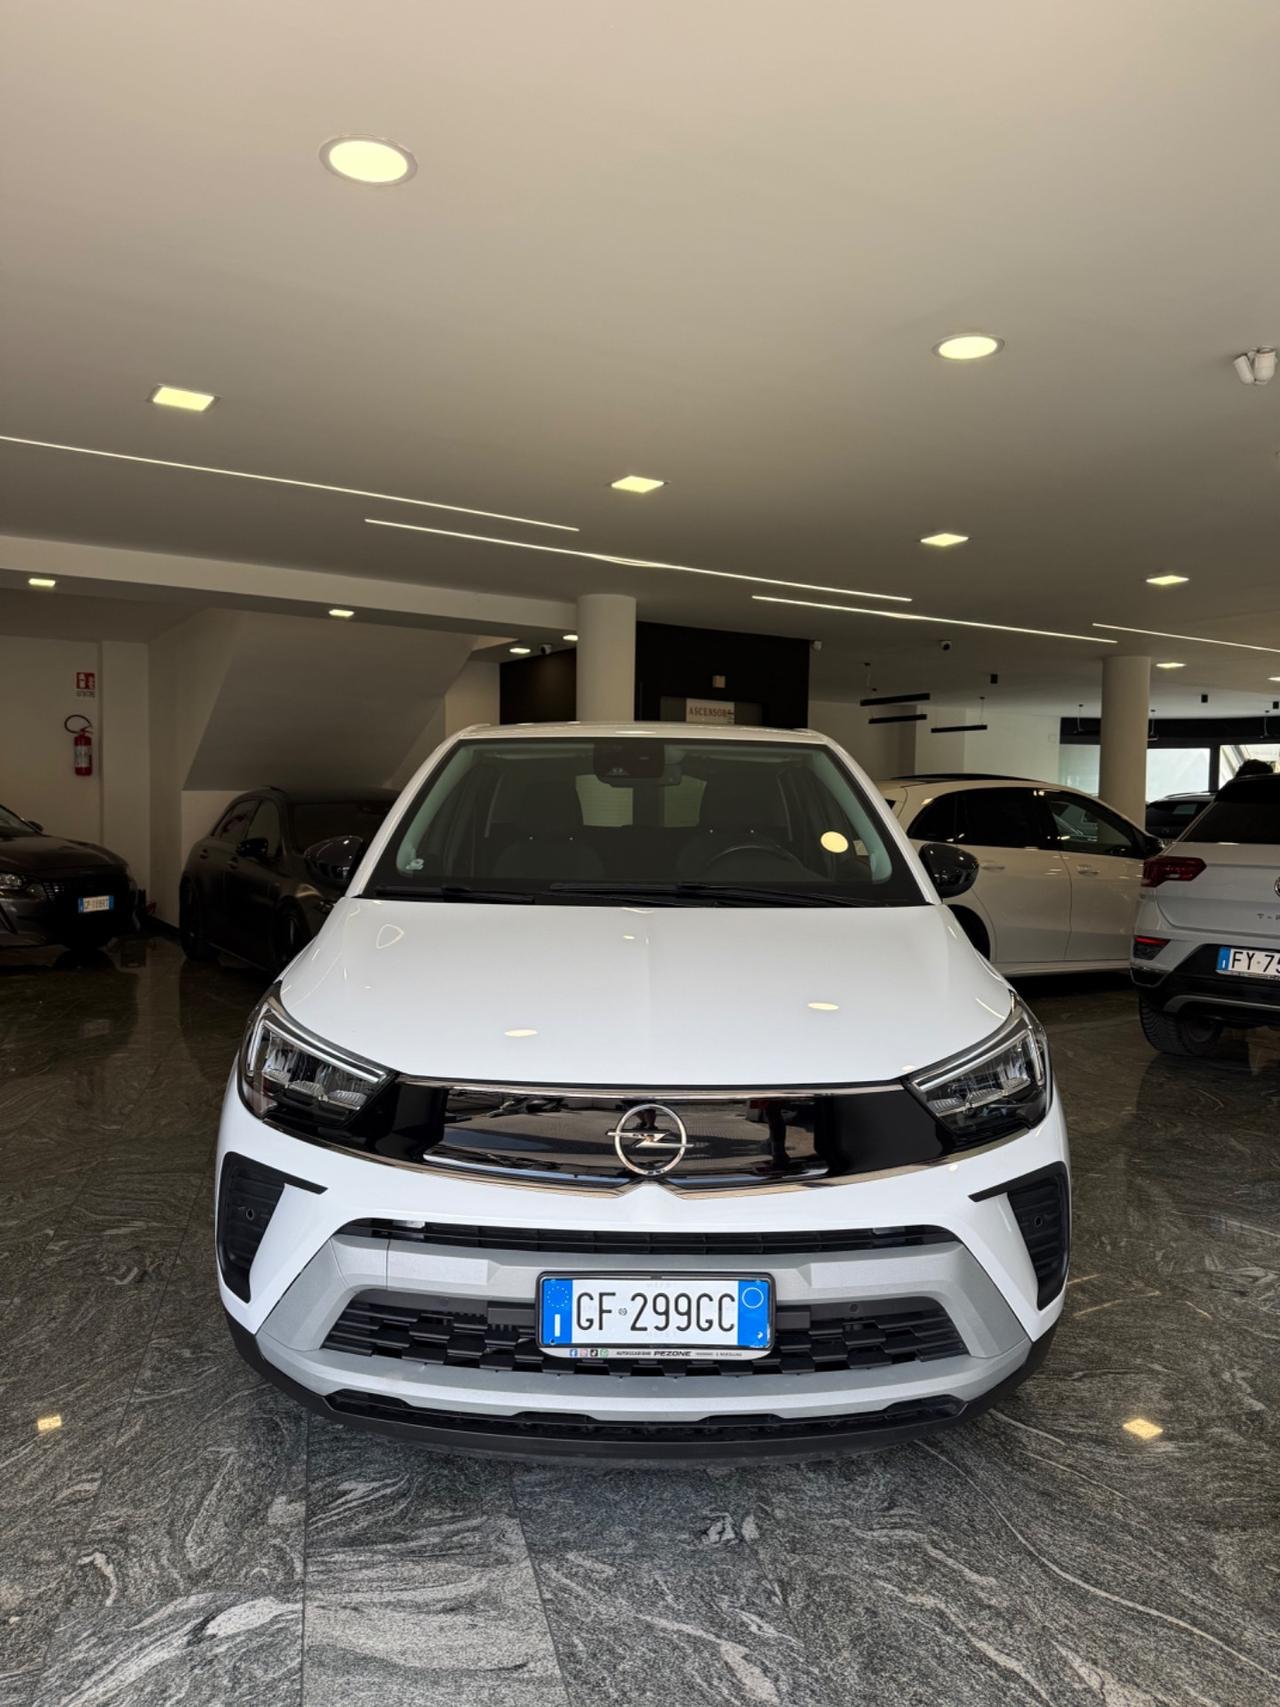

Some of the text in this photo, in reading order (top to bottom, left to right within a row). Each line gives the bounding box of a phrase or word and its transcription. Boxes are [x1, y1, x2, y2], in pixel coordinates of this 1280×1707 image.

[1231, 951, 1256, 970] FY
[576, 1292, 736, 1333] GF 299GC
